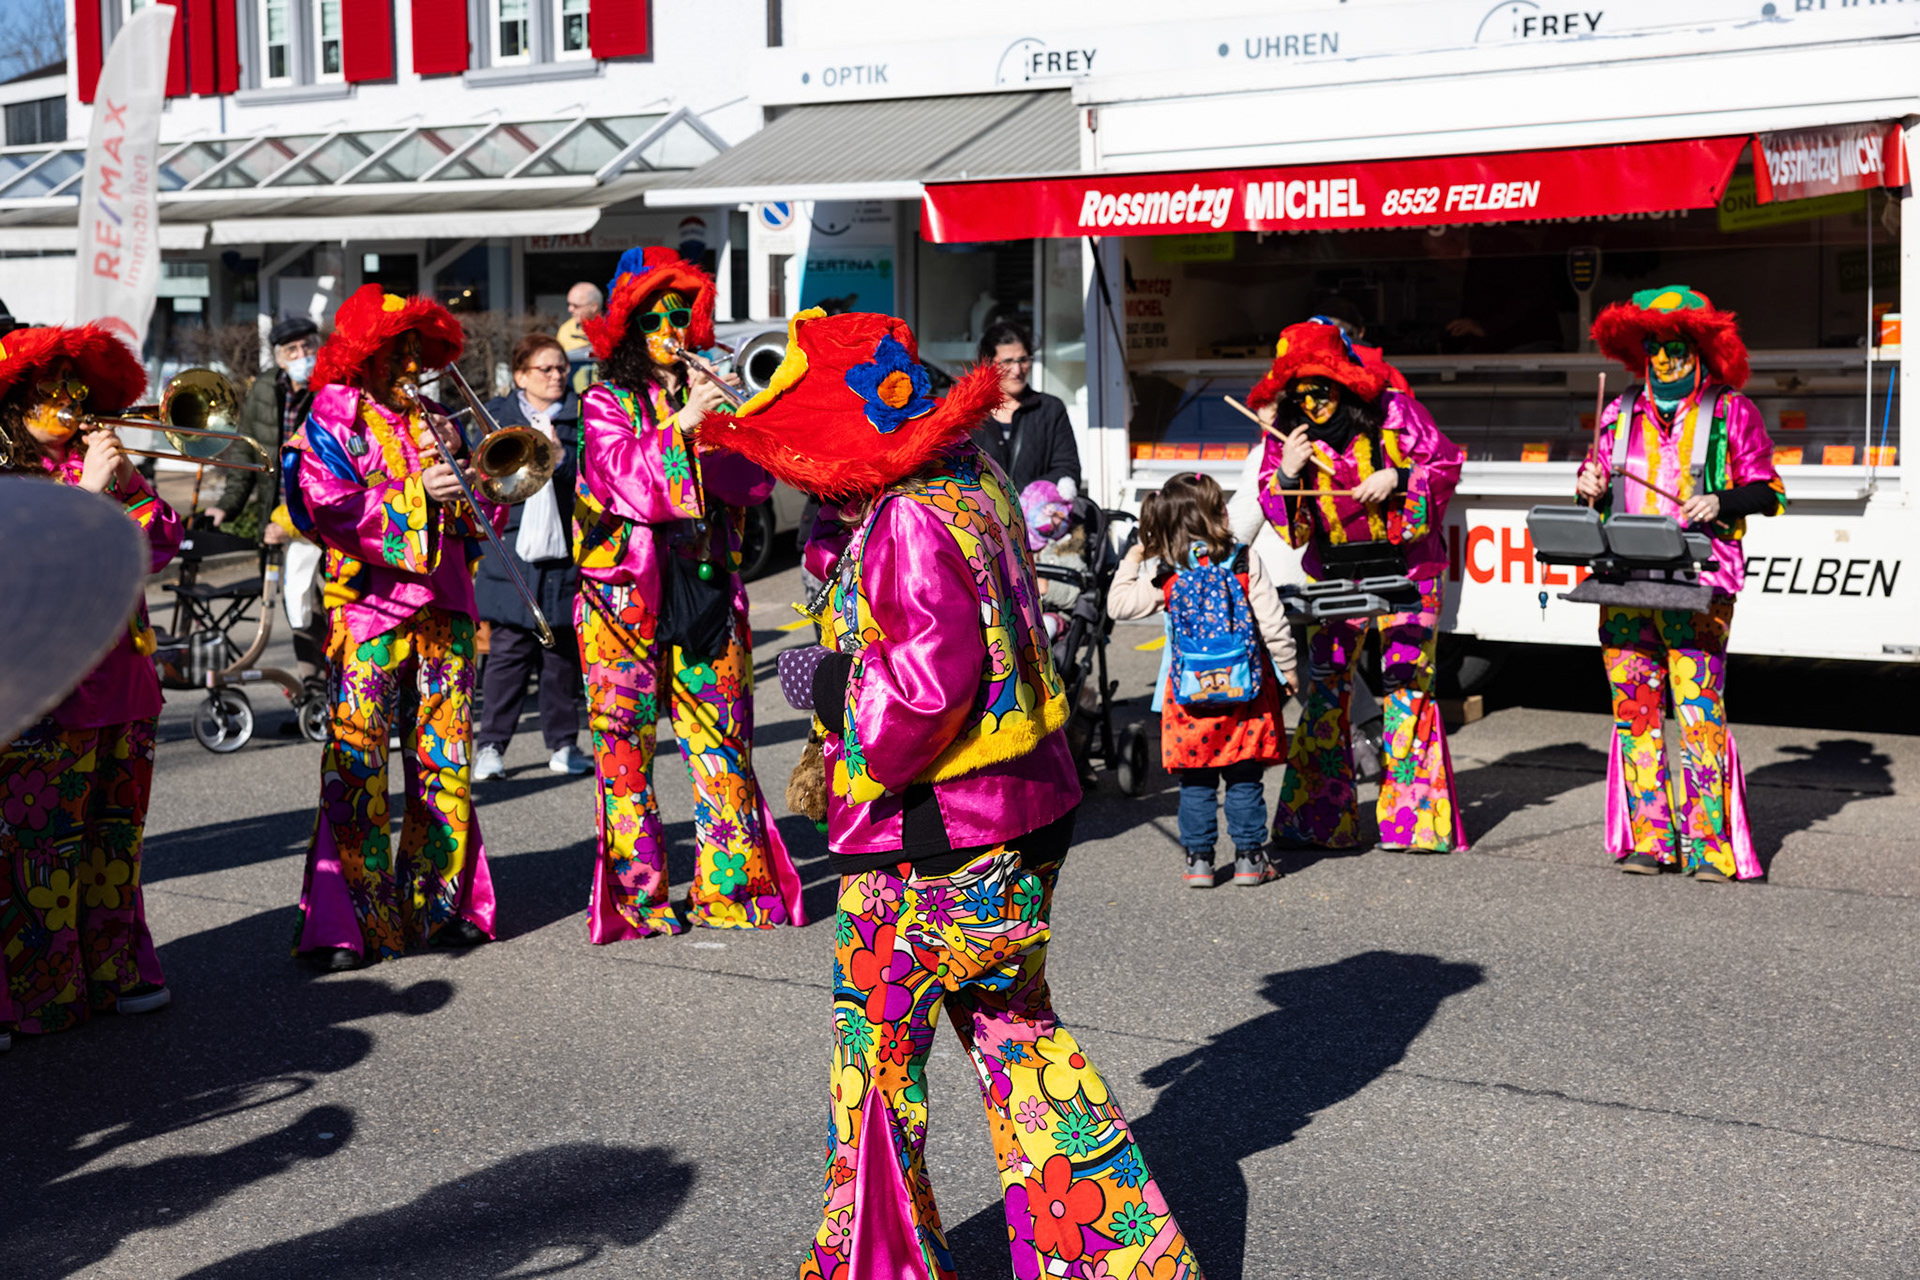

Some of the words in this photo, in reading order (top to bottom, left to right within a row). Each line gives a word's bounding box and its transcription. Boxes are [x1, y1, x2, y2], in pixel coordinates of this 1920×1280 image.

[1245, 32, 1339, 60] UHREN
[822, 64, 888, 87] OPTIK
[93, 98, 127, 281] RE/MAX
[1078, 183, 1234, 228] Rossmetzg
[1244, 177, 1366, 220] MICHEL
[1381, 186, 1440, 216] 8552
[1443, 180, 1541, 213] FELBEN
[806, 259, 875, 272] CERTINA
[1744, 556, 1902, 597] FELBEN
